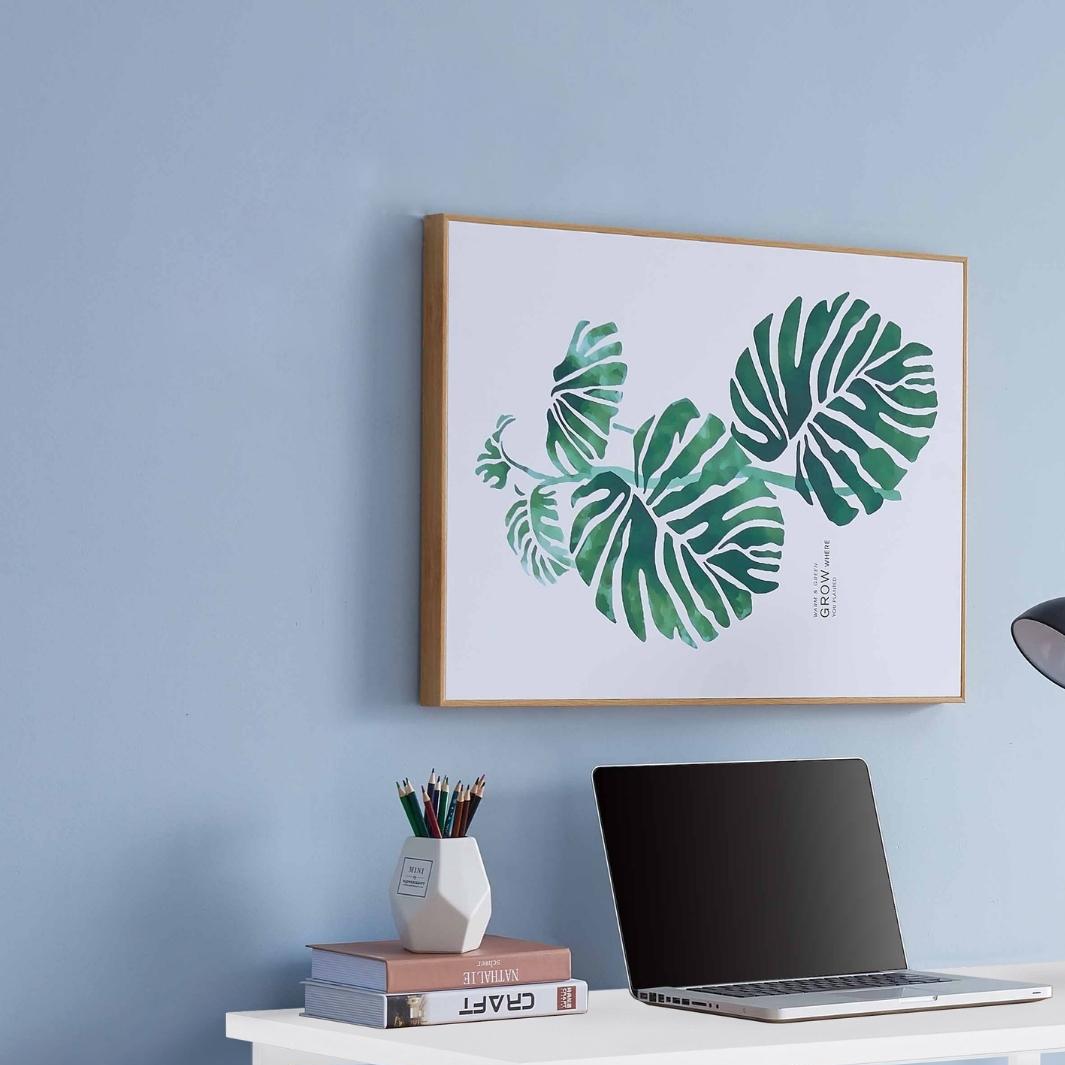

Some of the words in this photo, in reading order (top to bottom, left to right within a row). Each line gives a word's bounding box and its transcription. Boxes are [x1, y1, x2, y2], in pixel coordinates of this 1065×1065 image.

[820, 569, 830, 618] GROW
[463, 968, 519, 985] NATHALIE
[458, 992, 536, 1016] CRAFT
